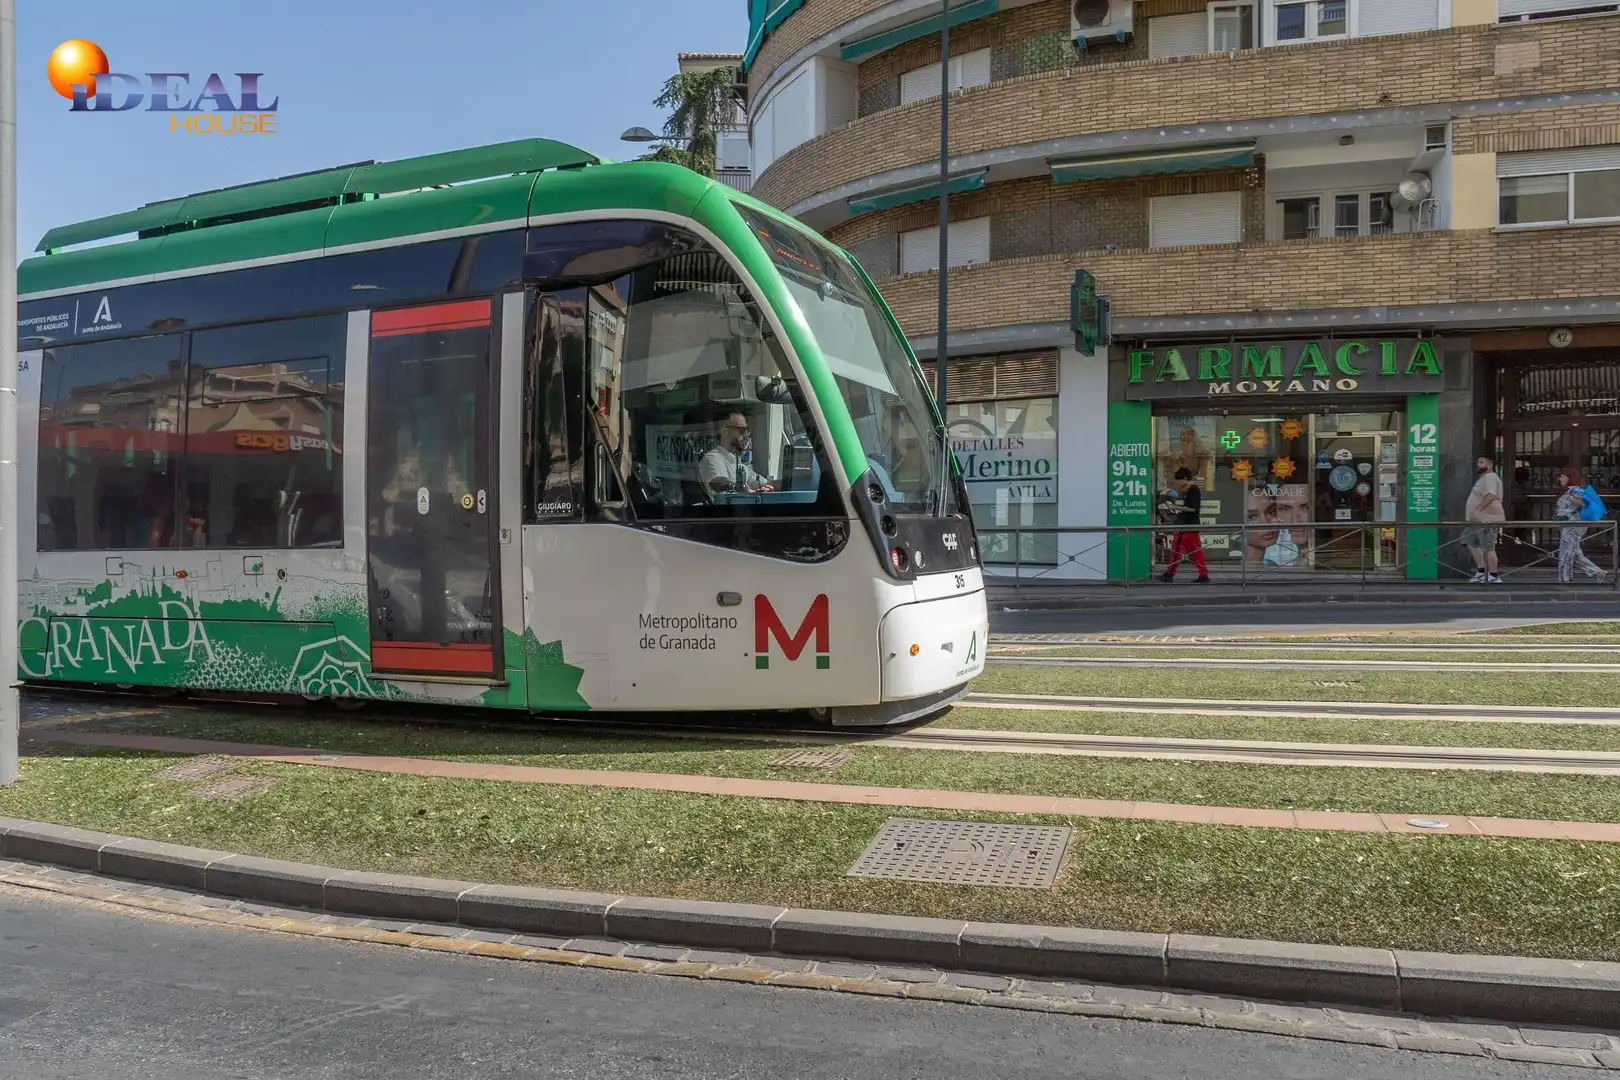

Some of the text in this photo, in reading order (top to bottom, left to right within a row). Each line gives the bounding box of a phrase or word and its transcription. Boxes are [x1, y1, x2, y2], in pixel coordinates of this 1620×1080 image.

[1128, 339, 1443, 384] FARMACIA
[1207, 378, 1358, 394] MOYANO
[1410, 423, 1437, 444] 12
[952, 436, 1025, 451] DETALLES
[1110, 443, 1150, 457] ABIERTO
[1410, 444, 1437, 453] horas
[1112, 460, 1148, 476] 9h a
[1007, 481, 1053, 498] ÁVILA
[1112, 480, 1147, 496] 21h
[538, 502, 572, 510] GIUGIARO
[1112, 499, 1147, 507] De Lunes
[638, 612, 738, 632] Metropolitano
[18, 600, 216, 678] GRANADA
[754, 593, 830, 669] M
[639, 634, 716, 650] de Granada
